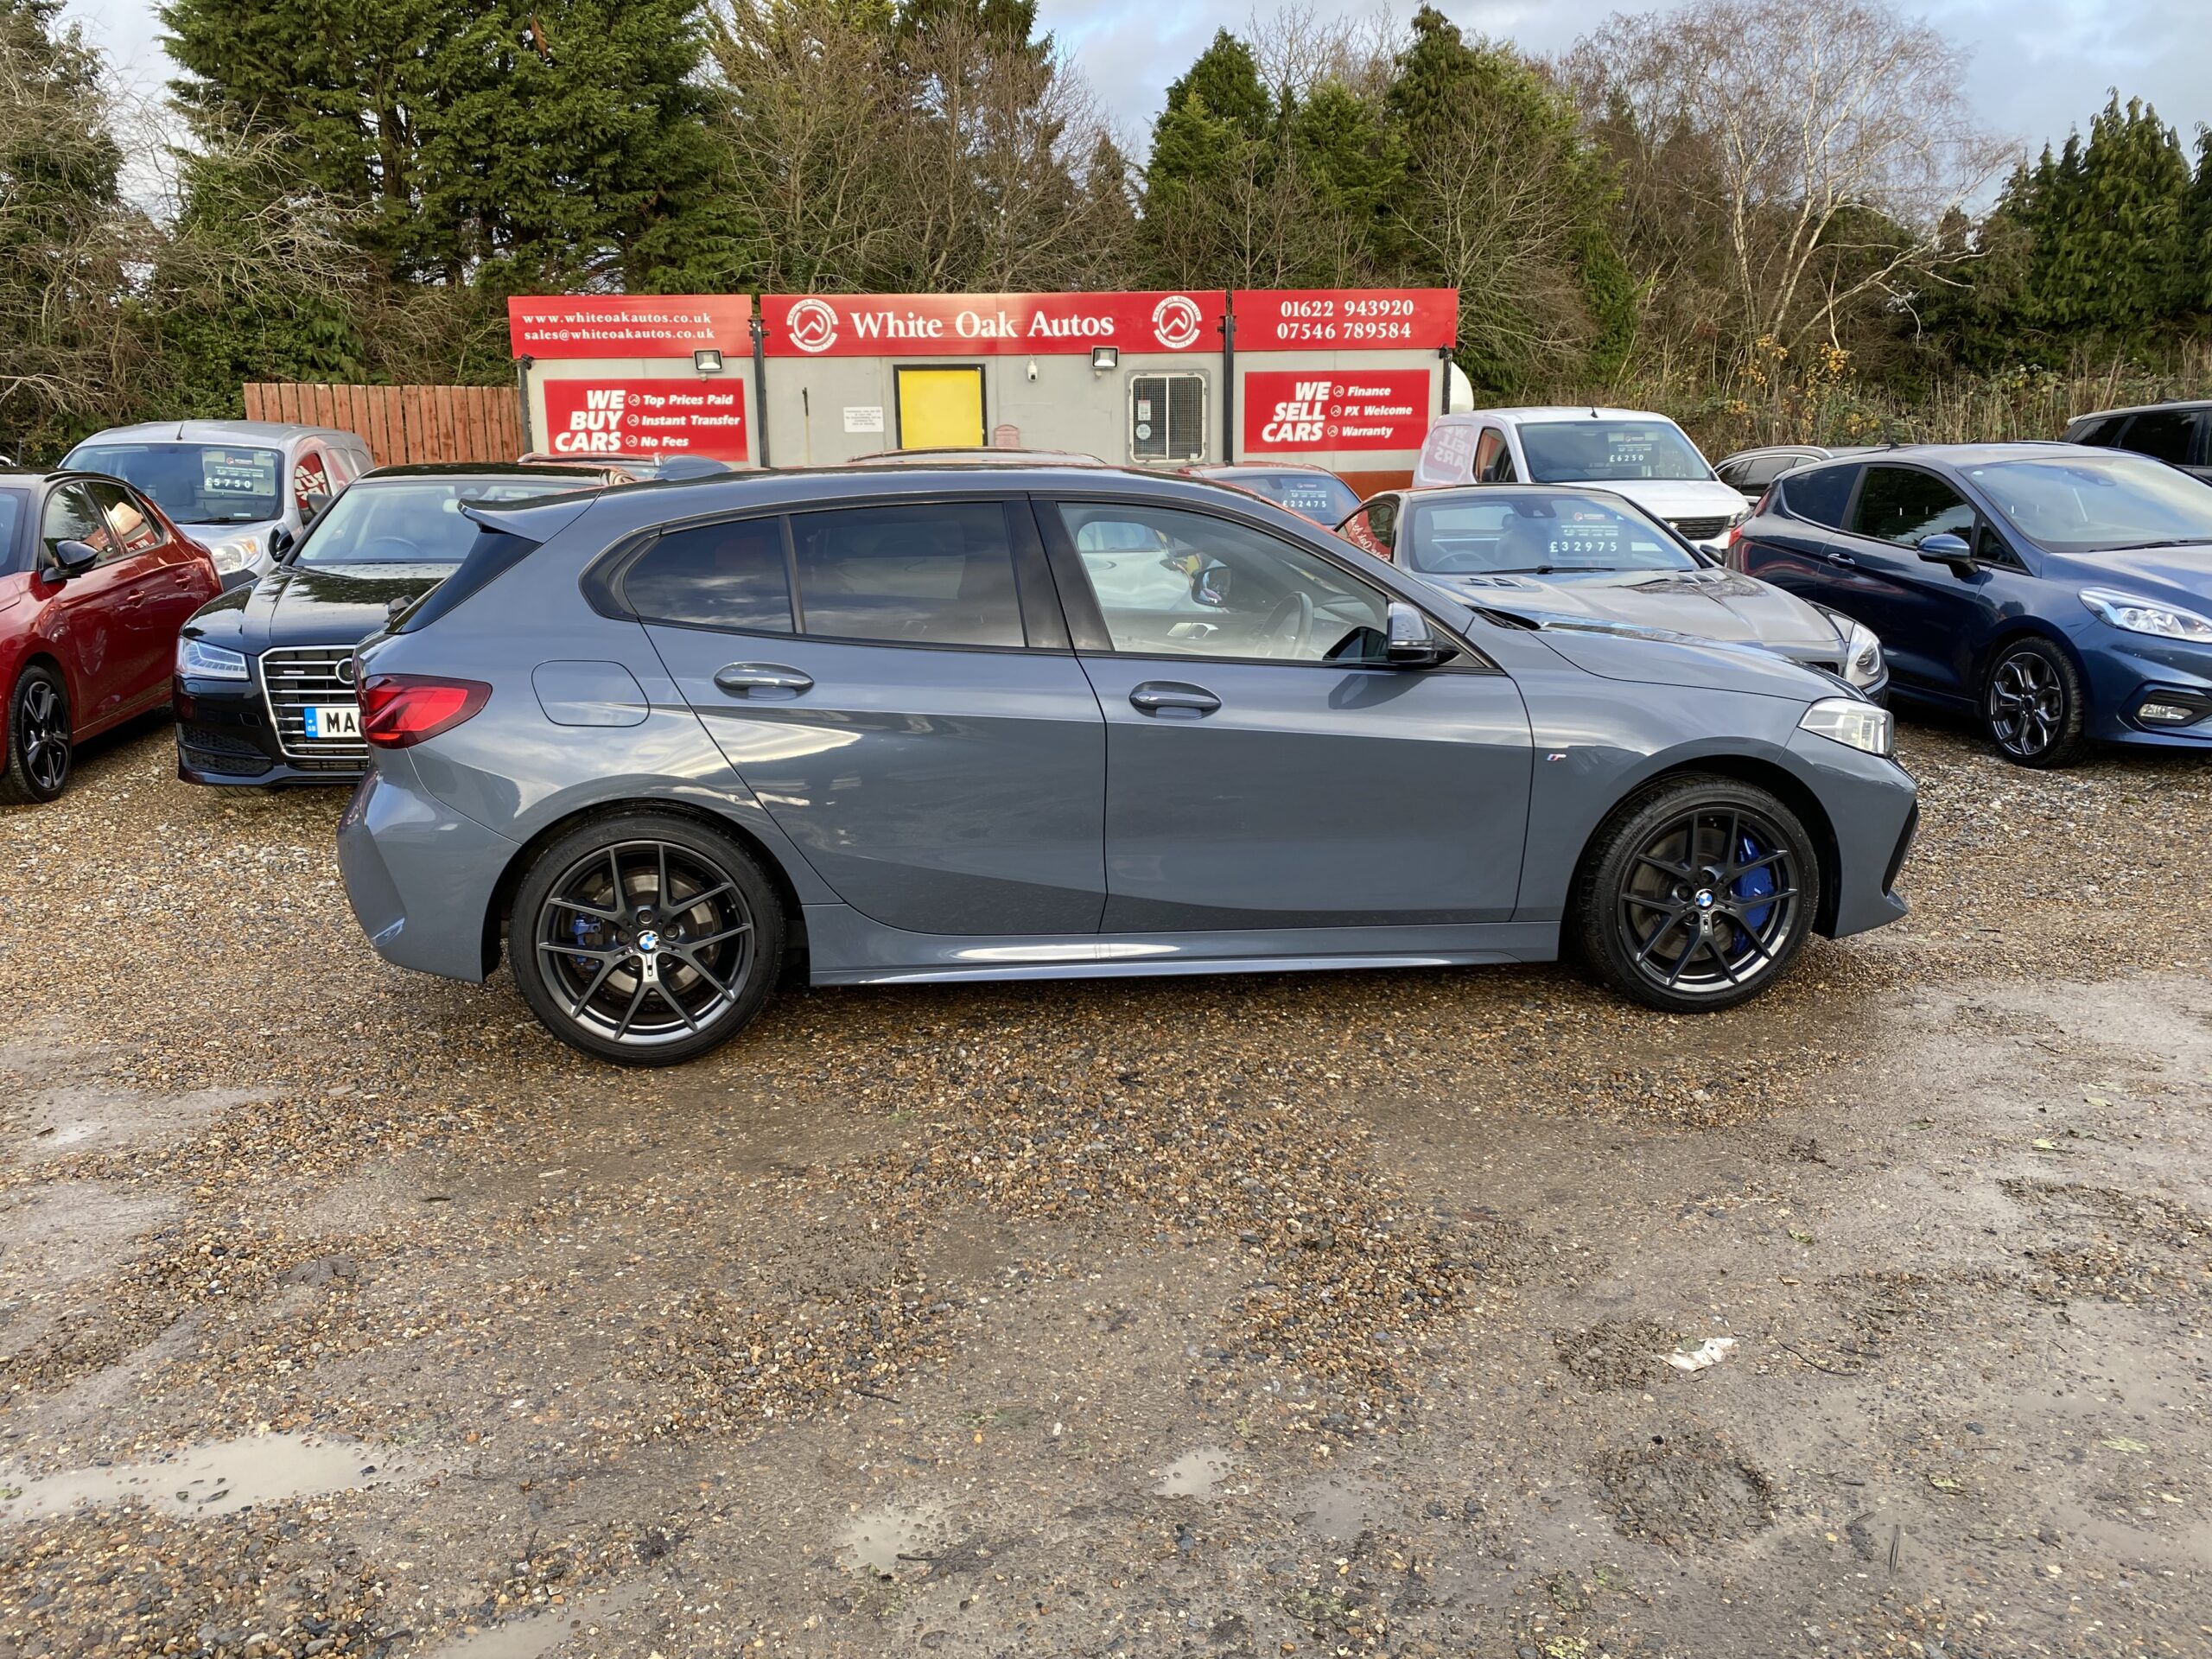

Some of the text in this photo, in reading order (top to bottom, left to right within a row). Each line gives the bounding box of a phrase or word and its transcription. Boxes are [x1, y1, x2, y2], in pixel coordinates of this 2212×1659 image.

[1281, 300, 1414, 317] 01622 943920
[522, 311, 712, 324] www.whiteoakautos.co.uk
[850, 311, 1115, 338] White Oak Autos
[1276, 322, 1411, 340] 07546 789584
[524, 328, 715, 341] sales@whiteoakautos.co.uk
[1295, 381, 1332, 401] WE
[1347, 386, 1391, 397] Finance
[587, 390, 626, 410] WE
[643, 394, 734, 407] Top Prices Paid
[1273, 402, 1325, 422] SELL
[1344, 405, 1413, 416] PX Welcome
[569, 410, 624, 430] BUY
[641, 415, 741, 426] Instant Transfer
[1262, 423, 1323, 442] CARS
[1342, 426, 1393, 439] Warranty
[555, 431, 621, 452] CARS
[640, 436, 690, 447] No Fees
[1609, 454, 1644, 462] £6250
[205, 477, 251, 489] £5750
[1282, 499, 1326, 508] £22475
[1549, 541, 1618, 553] £32975
